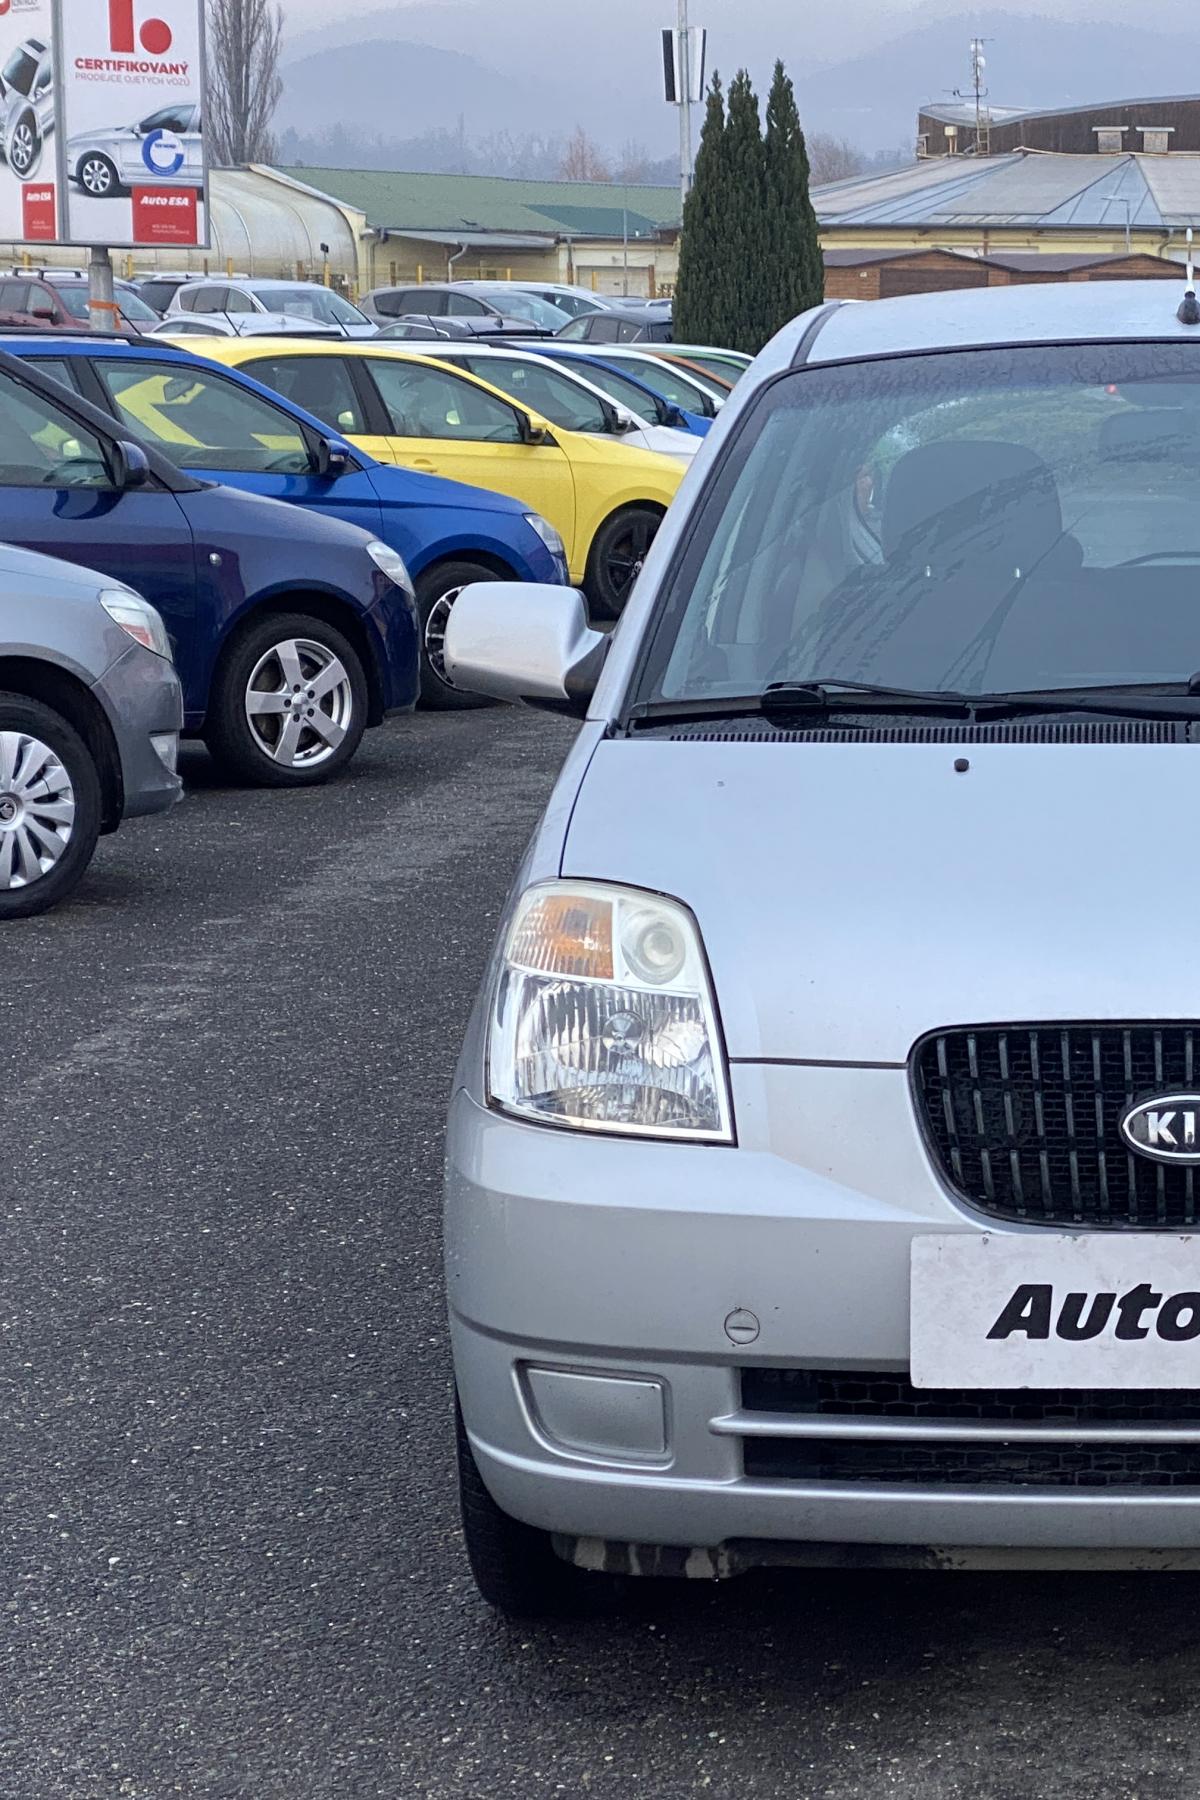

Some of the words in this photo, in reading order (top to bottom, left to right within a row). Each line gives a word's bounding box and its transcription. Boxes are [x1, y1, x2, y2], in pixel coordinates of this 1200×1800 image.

[75, 58, 188, 75] CERTIFIKOVANÝ
[75, 72, 122, 83] PRODEJCE
[140, 195, 168, 206] Auto
[168, 196, 190, 207] ESA
